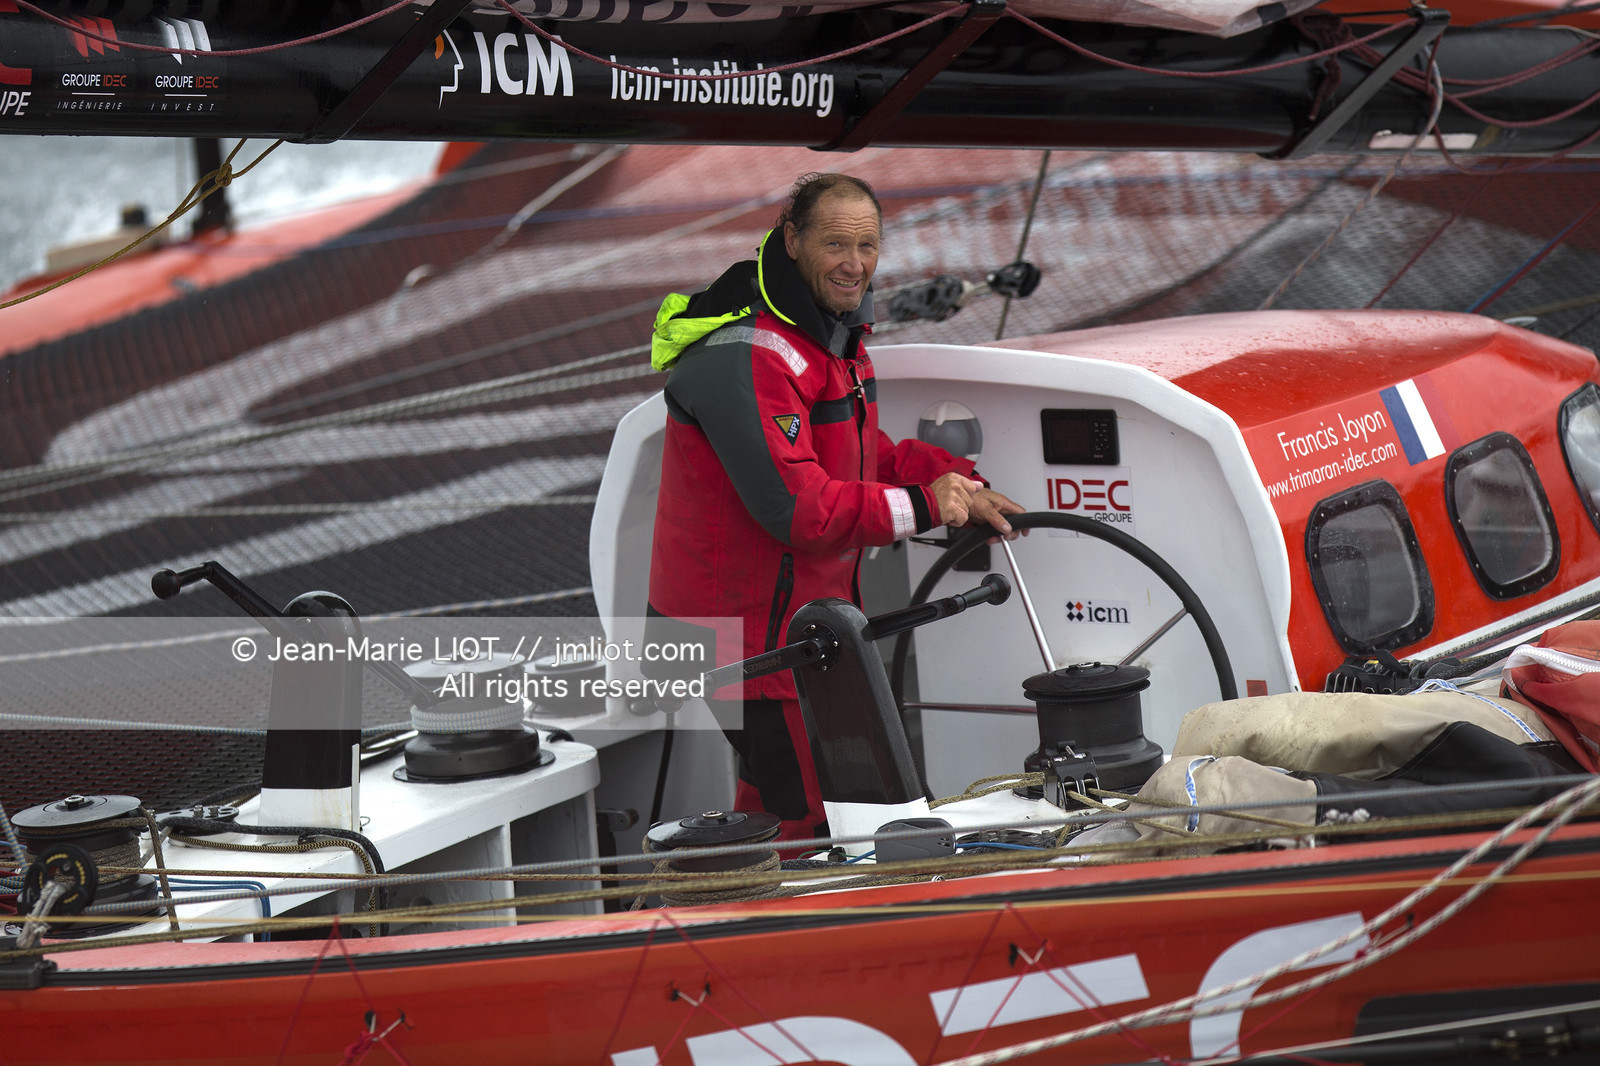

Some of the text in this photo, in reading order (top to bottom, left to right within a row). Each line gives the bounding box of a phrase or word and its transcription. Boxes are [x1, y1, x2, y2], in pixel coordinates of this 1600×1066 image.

[473, 31, 574, 97] ICM
[61, 73, 127, 88] GROUPE IDEC
[155, 75, 219, 89] GROUPE IDEC
[610, 54, 835, 118] icm-institute.org
[57, 100, 123, 111] INGÉNIERIE
[151, 103, 215, 112] INVEST
[787, 416, 800, 438] HPX
[1277, 410, 1387, 461] Francis Joyon
[1047, 478, 1131, 511] IDEC
[1094, 512, 1133, 523] GROUPE
[1087, 601, 1130, 624] icm
